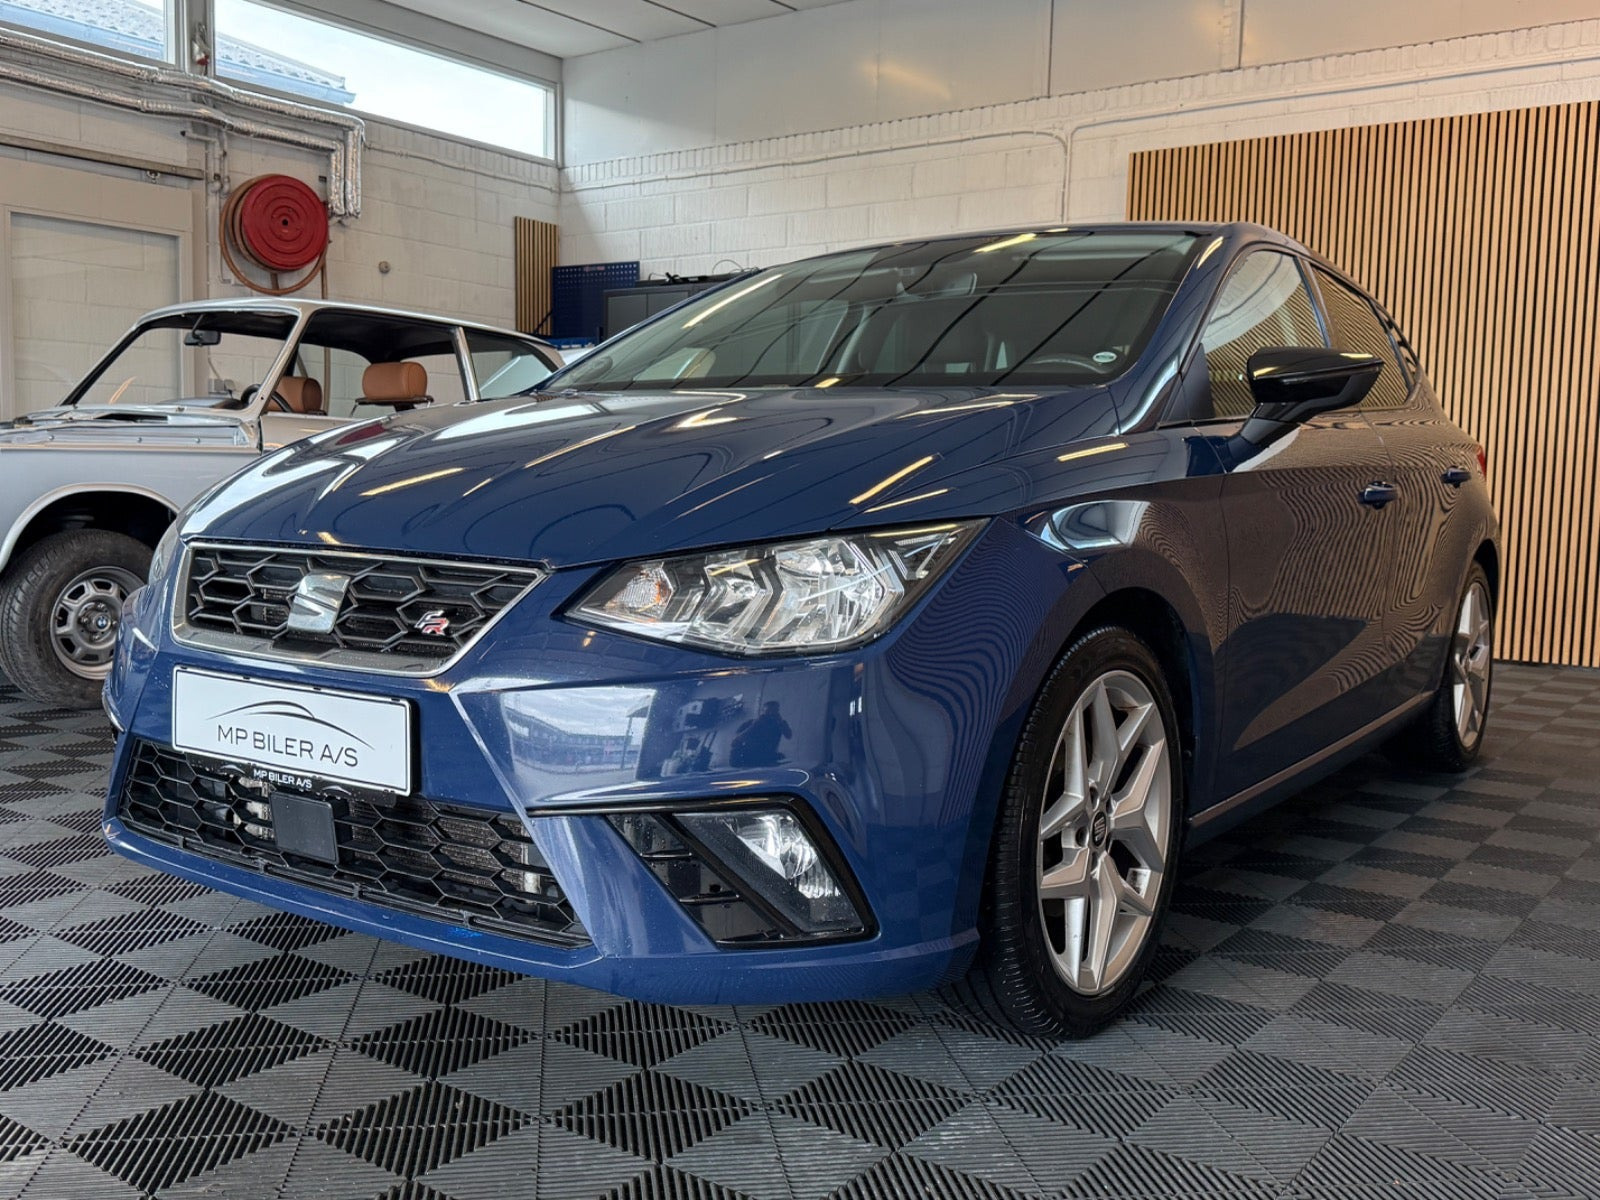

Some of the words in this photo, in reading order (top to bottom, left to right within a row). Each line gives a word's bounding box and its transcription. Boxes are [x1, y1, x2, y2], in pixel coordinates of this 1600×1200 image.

[217, 724, 248, 745] MP
[253, 731, 314, 760] BILER
[320, 744, 358, 768] A/S
[253, 768, 268, 779] MP
[268, 771, 295, 785] BILER
[296, 777, 313, 789] A/S
